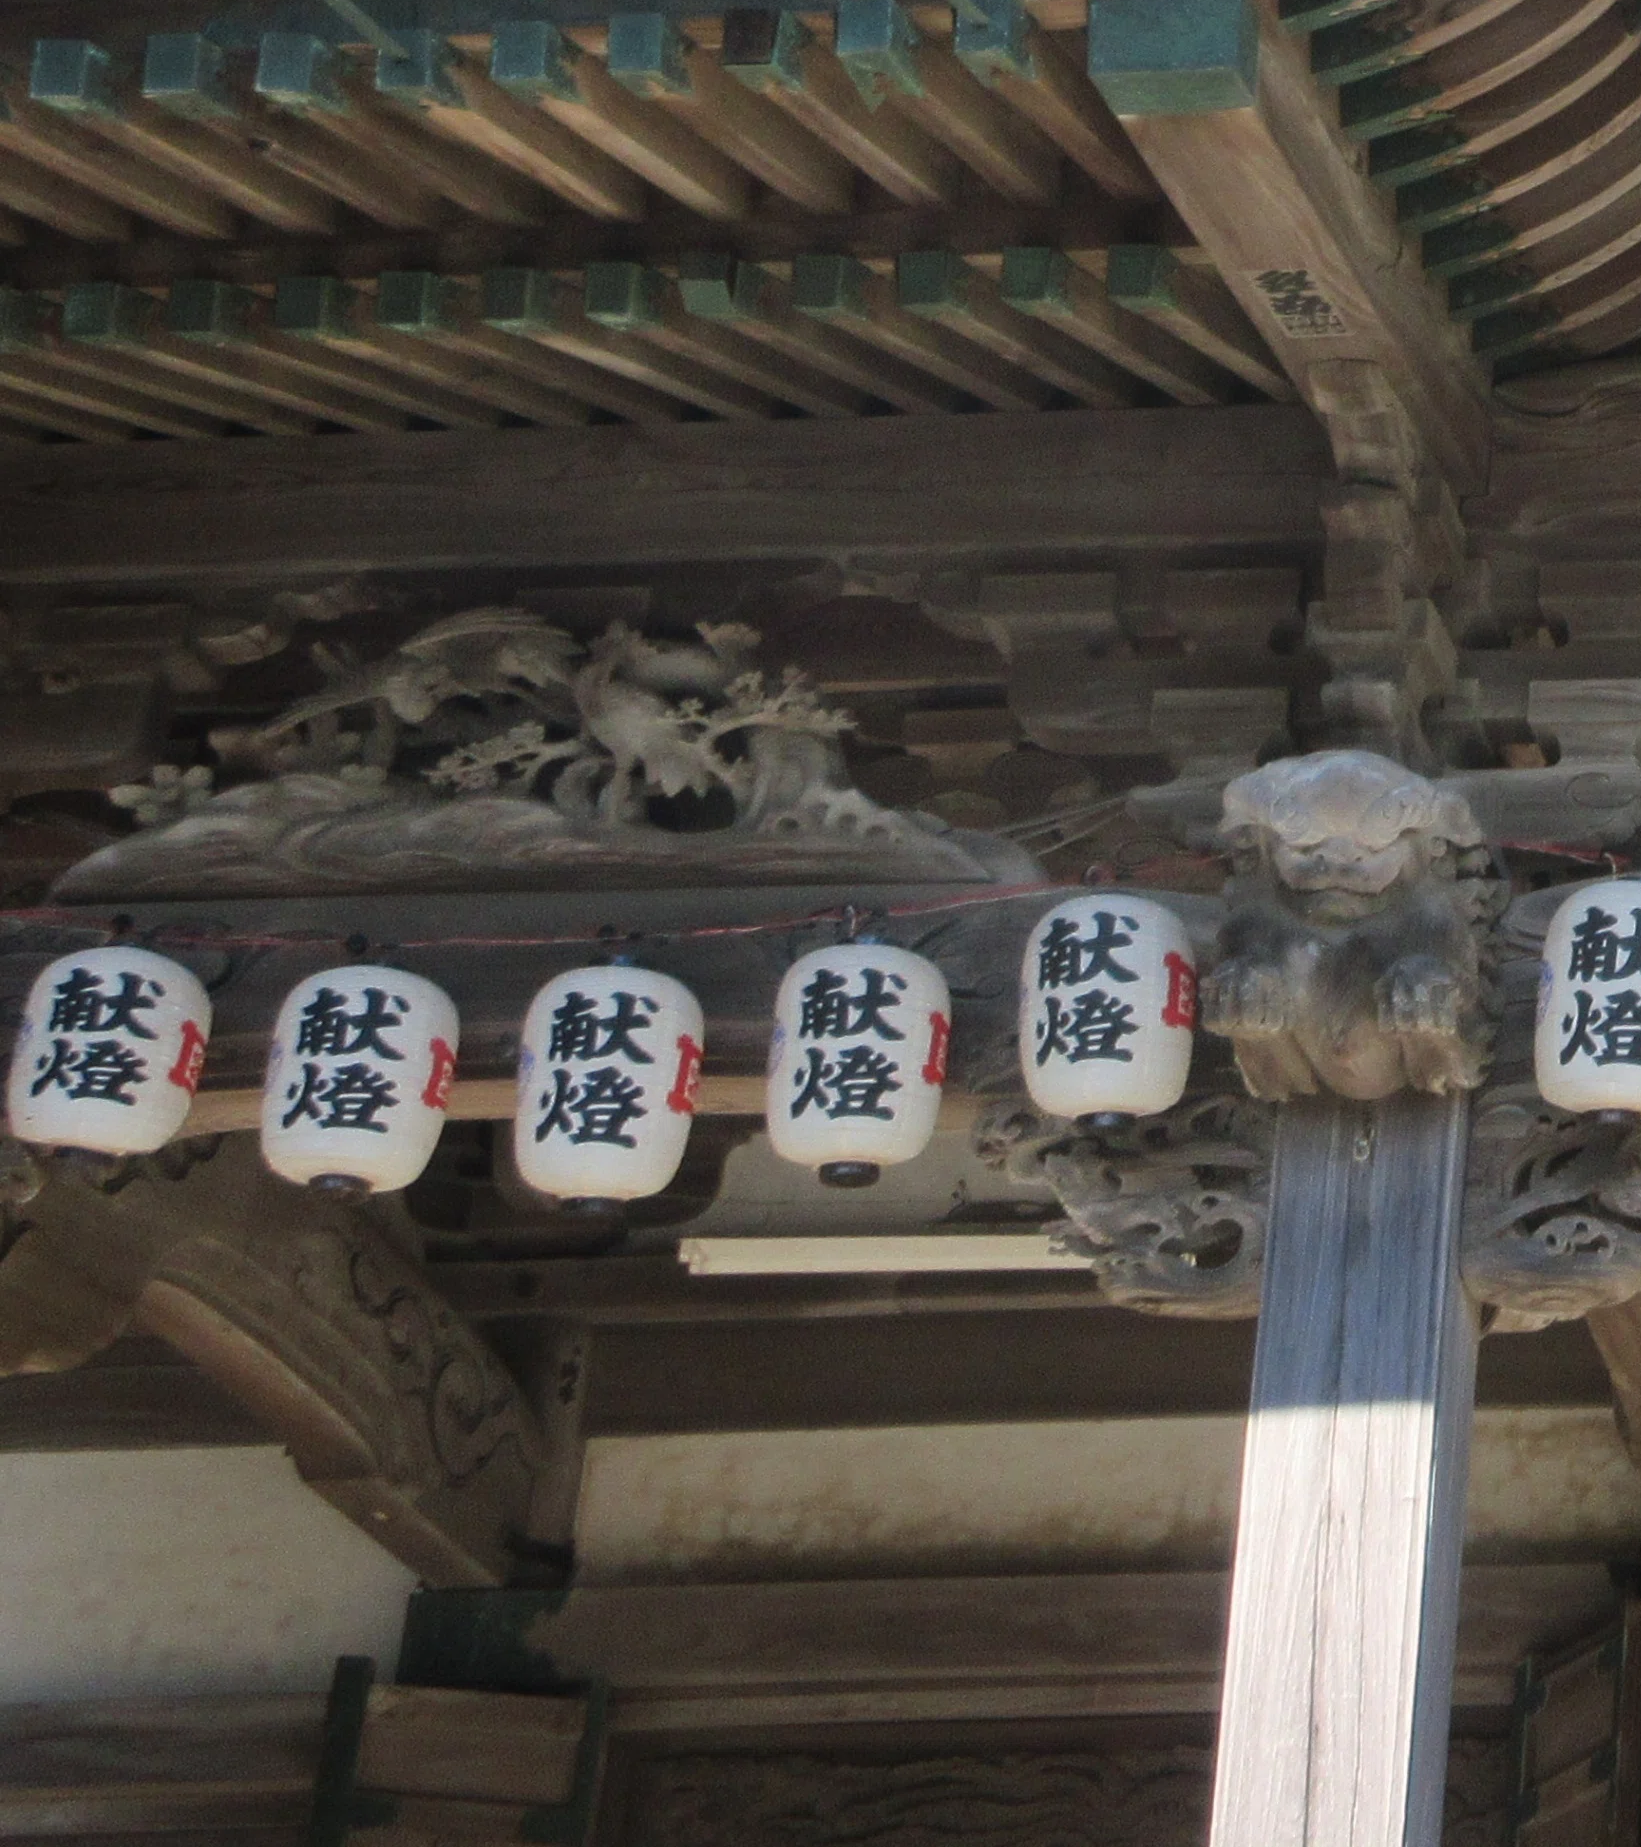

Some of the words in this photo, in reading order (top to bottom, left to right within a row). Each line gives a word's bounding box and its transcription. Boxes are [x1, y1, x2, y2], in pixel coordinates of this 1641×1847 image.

[31, 968, 165, 1105] 献燈
[283, 988, 409, 1132] 献燈
[791, 969, 907, 1120] 献燈
[1037, 912, 1139, 1065] 献燈
[536, 992, 658, 1148] 献燈
